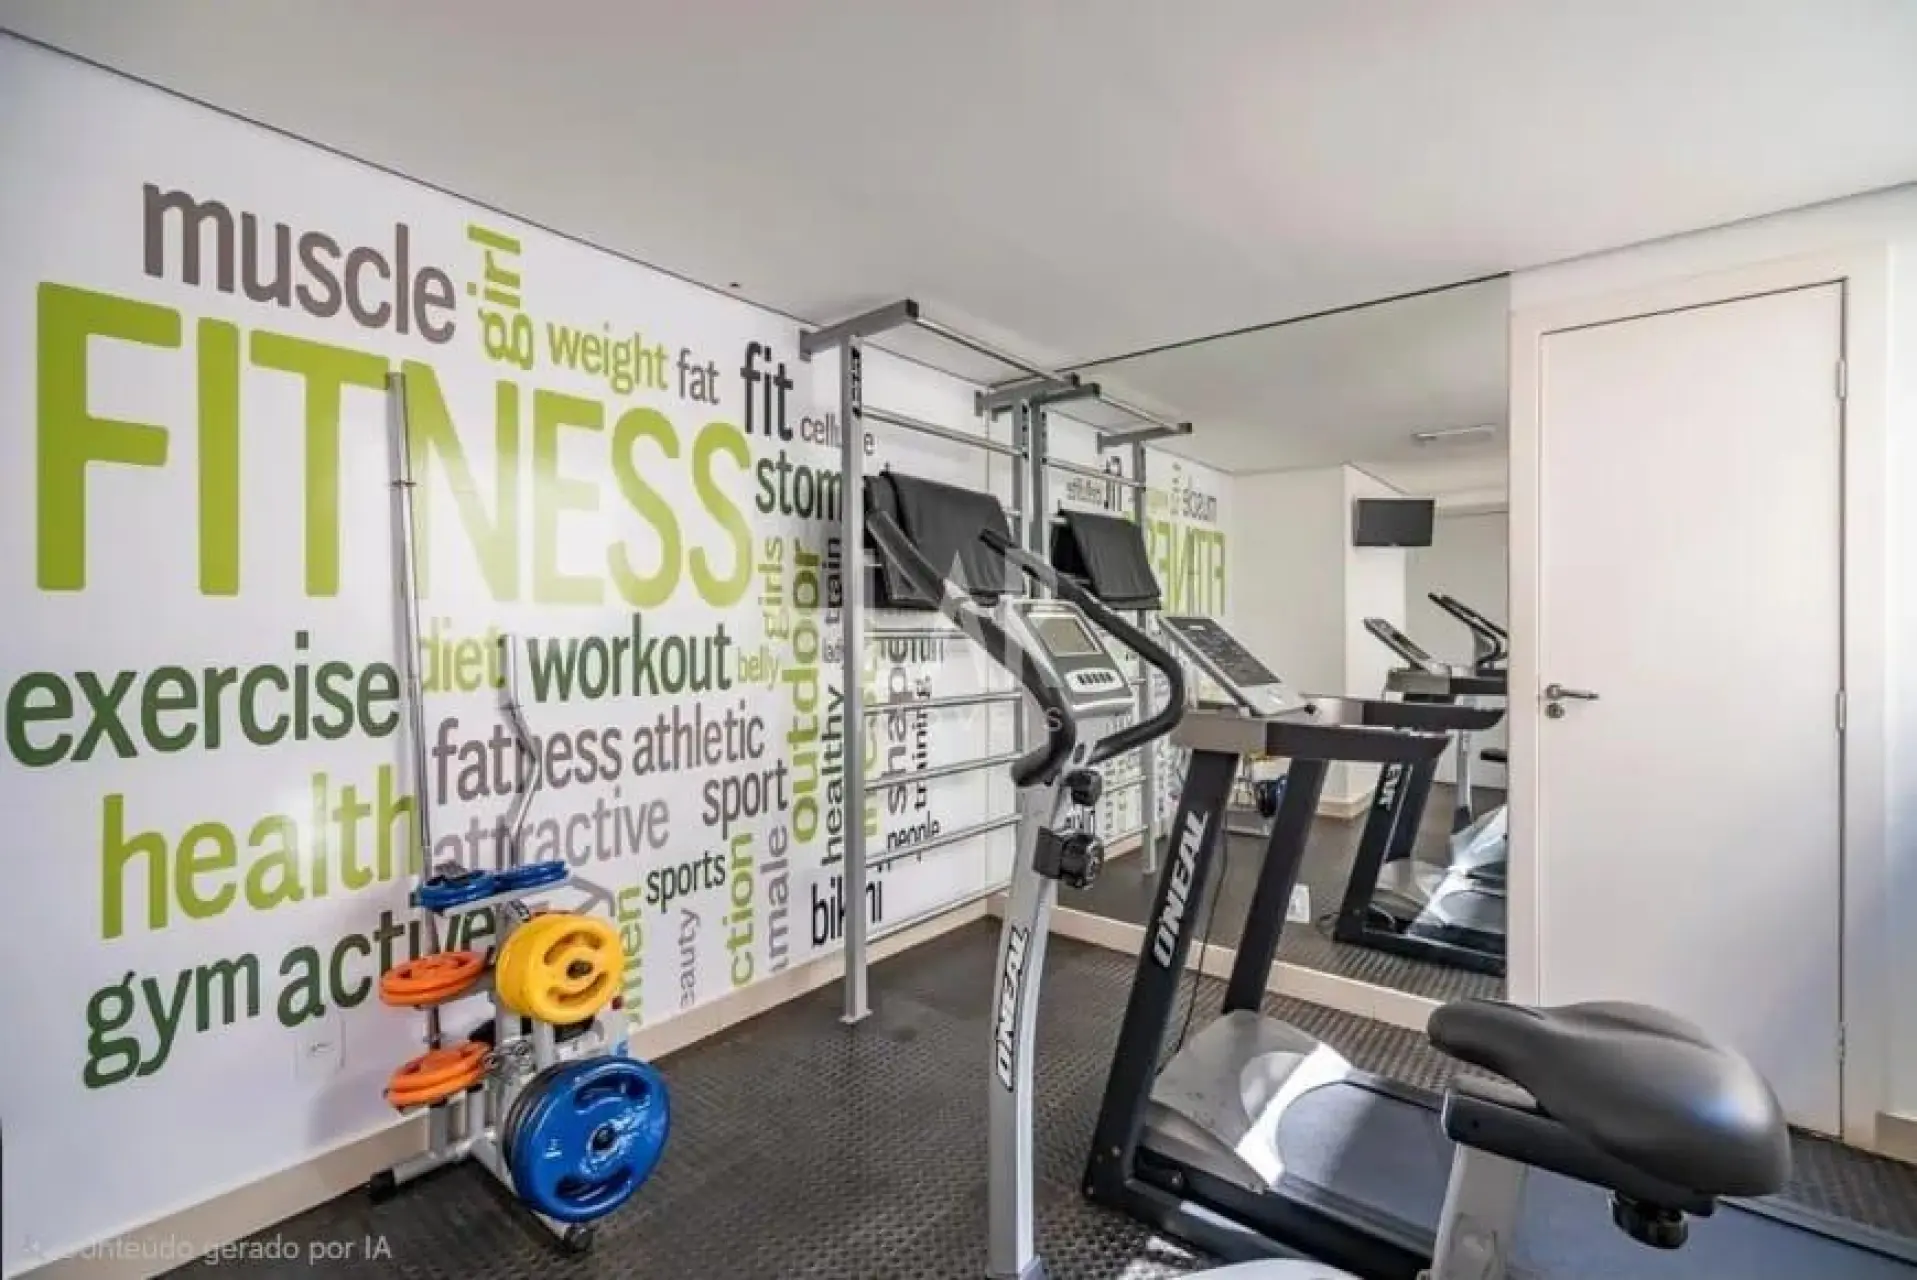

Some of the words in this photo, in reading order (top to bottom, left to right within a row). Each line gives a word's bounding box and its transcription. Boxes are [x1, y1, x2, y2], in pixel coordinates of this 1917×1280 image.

[143, 183, 456, 344] muscle
[467, 224, 534, 370] girl
[547, 321, 668, 395] weight
[677, 347, 720, 405] fat
[740, 341, 794, 441] fit
[37, 281, 752, 610] FITNESS
[758, 537, 790, 640] girls
[821, 537, 843, 624] train
[6, 630, 401, 767] exercise
[421, 617, 507, 695] diet
[527, 612, 732, 702] workout
[738, 645, 778, 691] belly
[782, 537, 821, 844] outdoor
[432, 717, 622, 805] fatness
[632, 700, 766, 777] athletic
[702, 759, 788, 840] sport
[821, 686, 844, 866] healthy
[101, 764, 421, 938] health
[433, 785, 670, 870] attractive
[646, 850, 726, 914] sports
[812, 863, 882, 945] bikni
[83, 954, 261, 1089] gym
